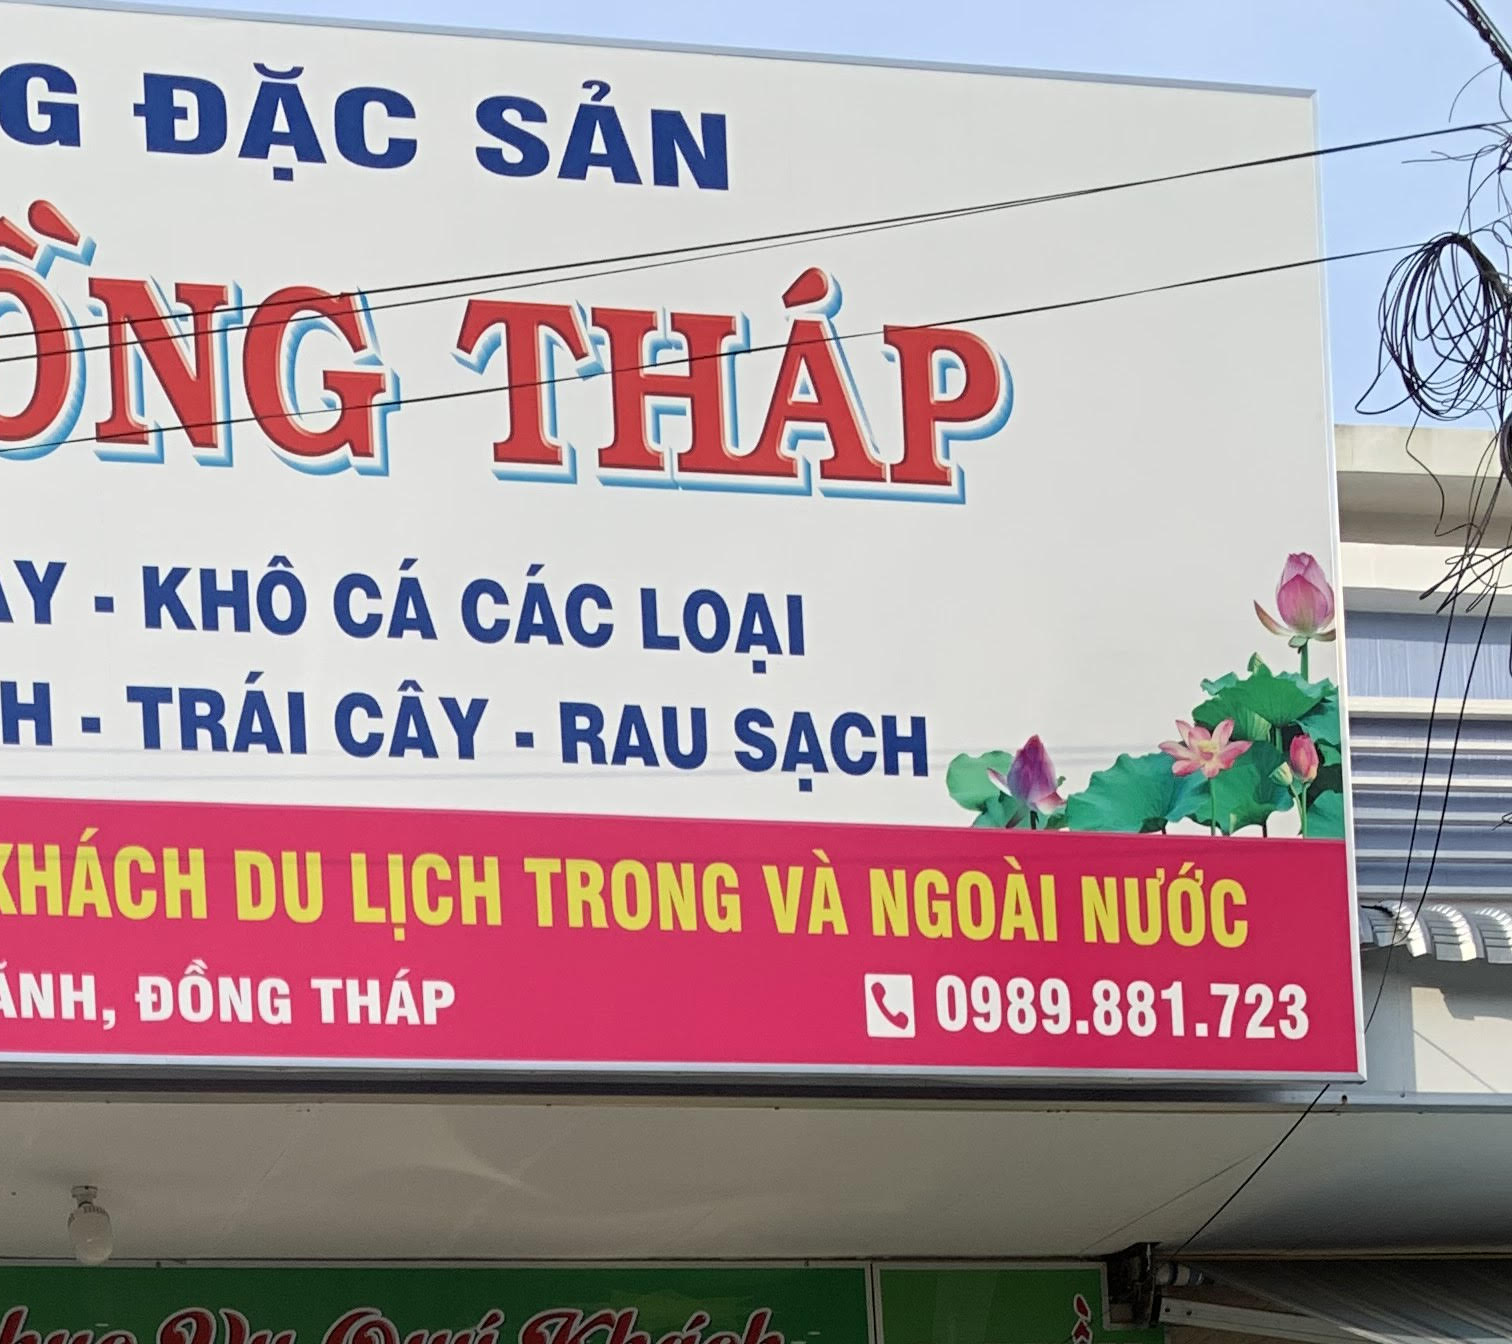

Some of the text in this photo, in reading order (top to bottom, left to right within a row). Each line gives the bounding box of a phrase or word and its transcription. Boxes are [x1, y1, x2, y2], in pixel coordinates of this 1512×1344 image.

[133, 62, 418, 182] ĐẶC
[475, 80, 729, 190] SẢN
[450, 267, 1013, 505] THÁP
[94, 596, 115, 613] -
[142, 555, 307, 636] KHÔ
[334, 558, 437, 641] CÁ
[461, 564, 614, 648] CÁC
[641, 587, 805, 674] LOẠI
[81, 716, 101, 734] -
[126, 672, 308, 755] TRÁI
[335, 680, 489, 760] CÂY
[515, 731, 535, 748] -
[559, 702, 708, 769] RAU
[734, 708, 930, 793] SẠCH
[233, 849, 324, 923] DU
[350, 852, 502, 940] LỊCH
[524, 857, 742, 932] TRONG
[764, 849, 849, 935] VÀ
[869, 856, 1059, 942] NGOÀI
[1082, 862, 1249, 949] NƯỚC
[135, 959, 292, 1025] ĐỒNG
[311, 969, 456, 1026] THÁP
[934, 974, 1311, 1041] 0989.881.723
